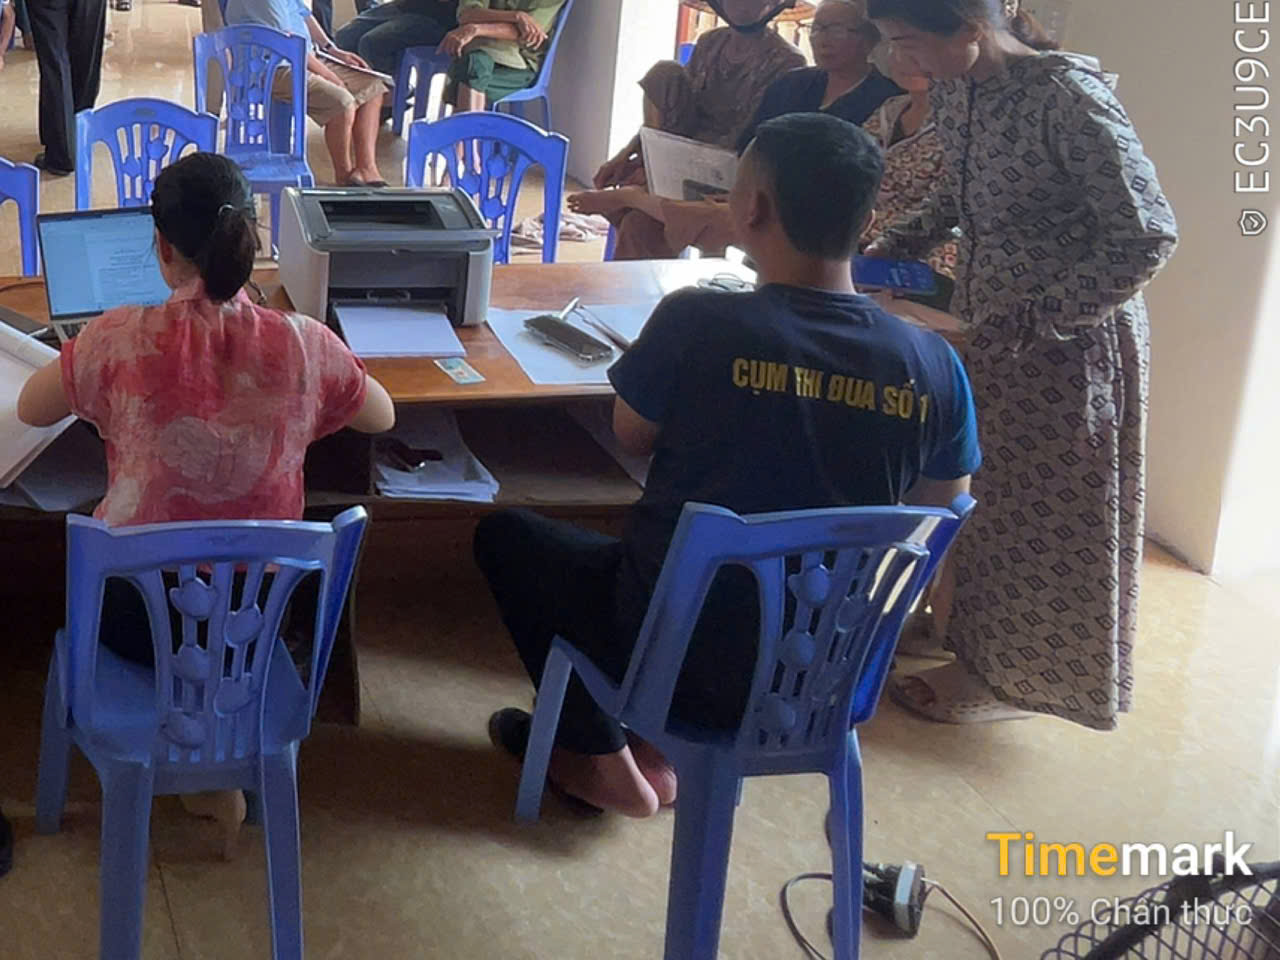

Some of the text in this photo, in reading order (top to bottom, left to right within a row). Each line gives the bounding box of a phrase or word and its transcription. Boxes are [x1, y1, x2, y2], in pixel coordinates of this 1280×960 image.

[732, 357, 929, 424] CỤM THI ĐUA SỐ 1
